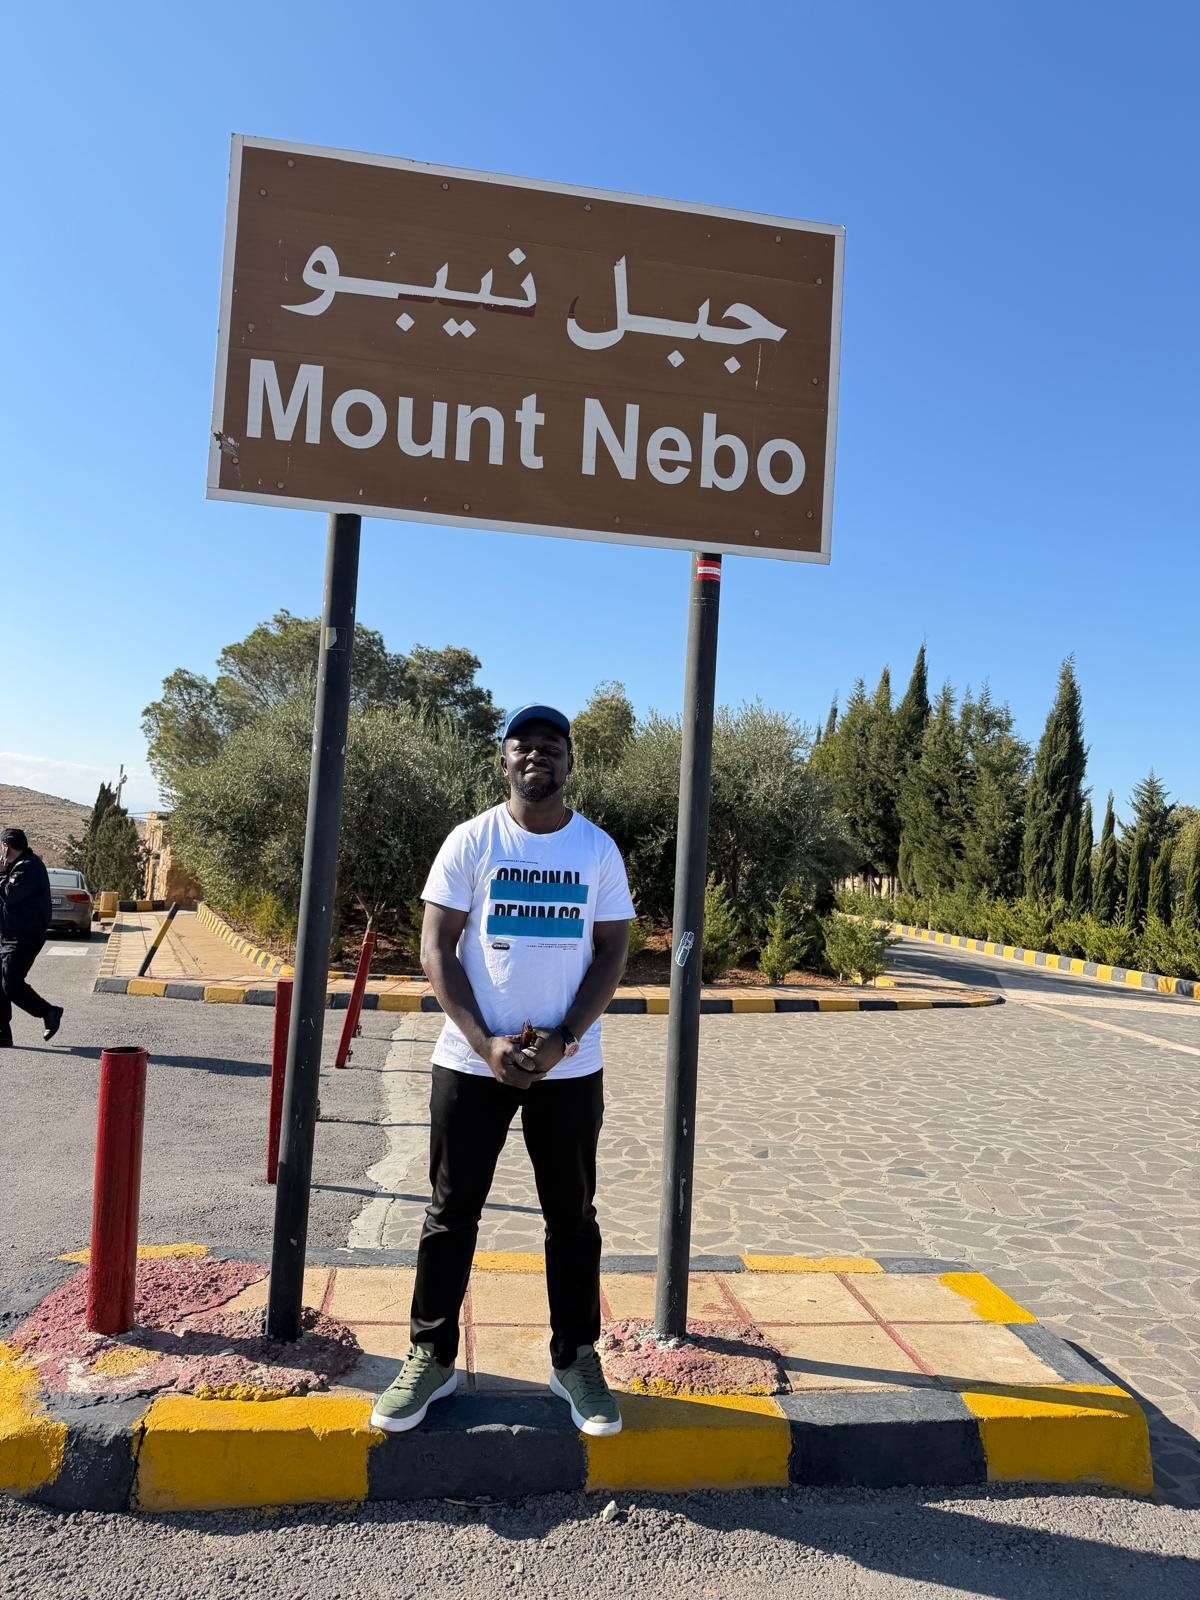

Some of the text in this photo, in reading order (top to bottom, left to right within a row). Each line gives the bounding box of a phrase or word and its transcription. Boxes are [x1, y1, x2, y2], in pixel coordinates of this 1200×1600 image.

[280, 246, 787, 374] جبل نيبو
[246, 358, 806, 496] Mount Nebo
